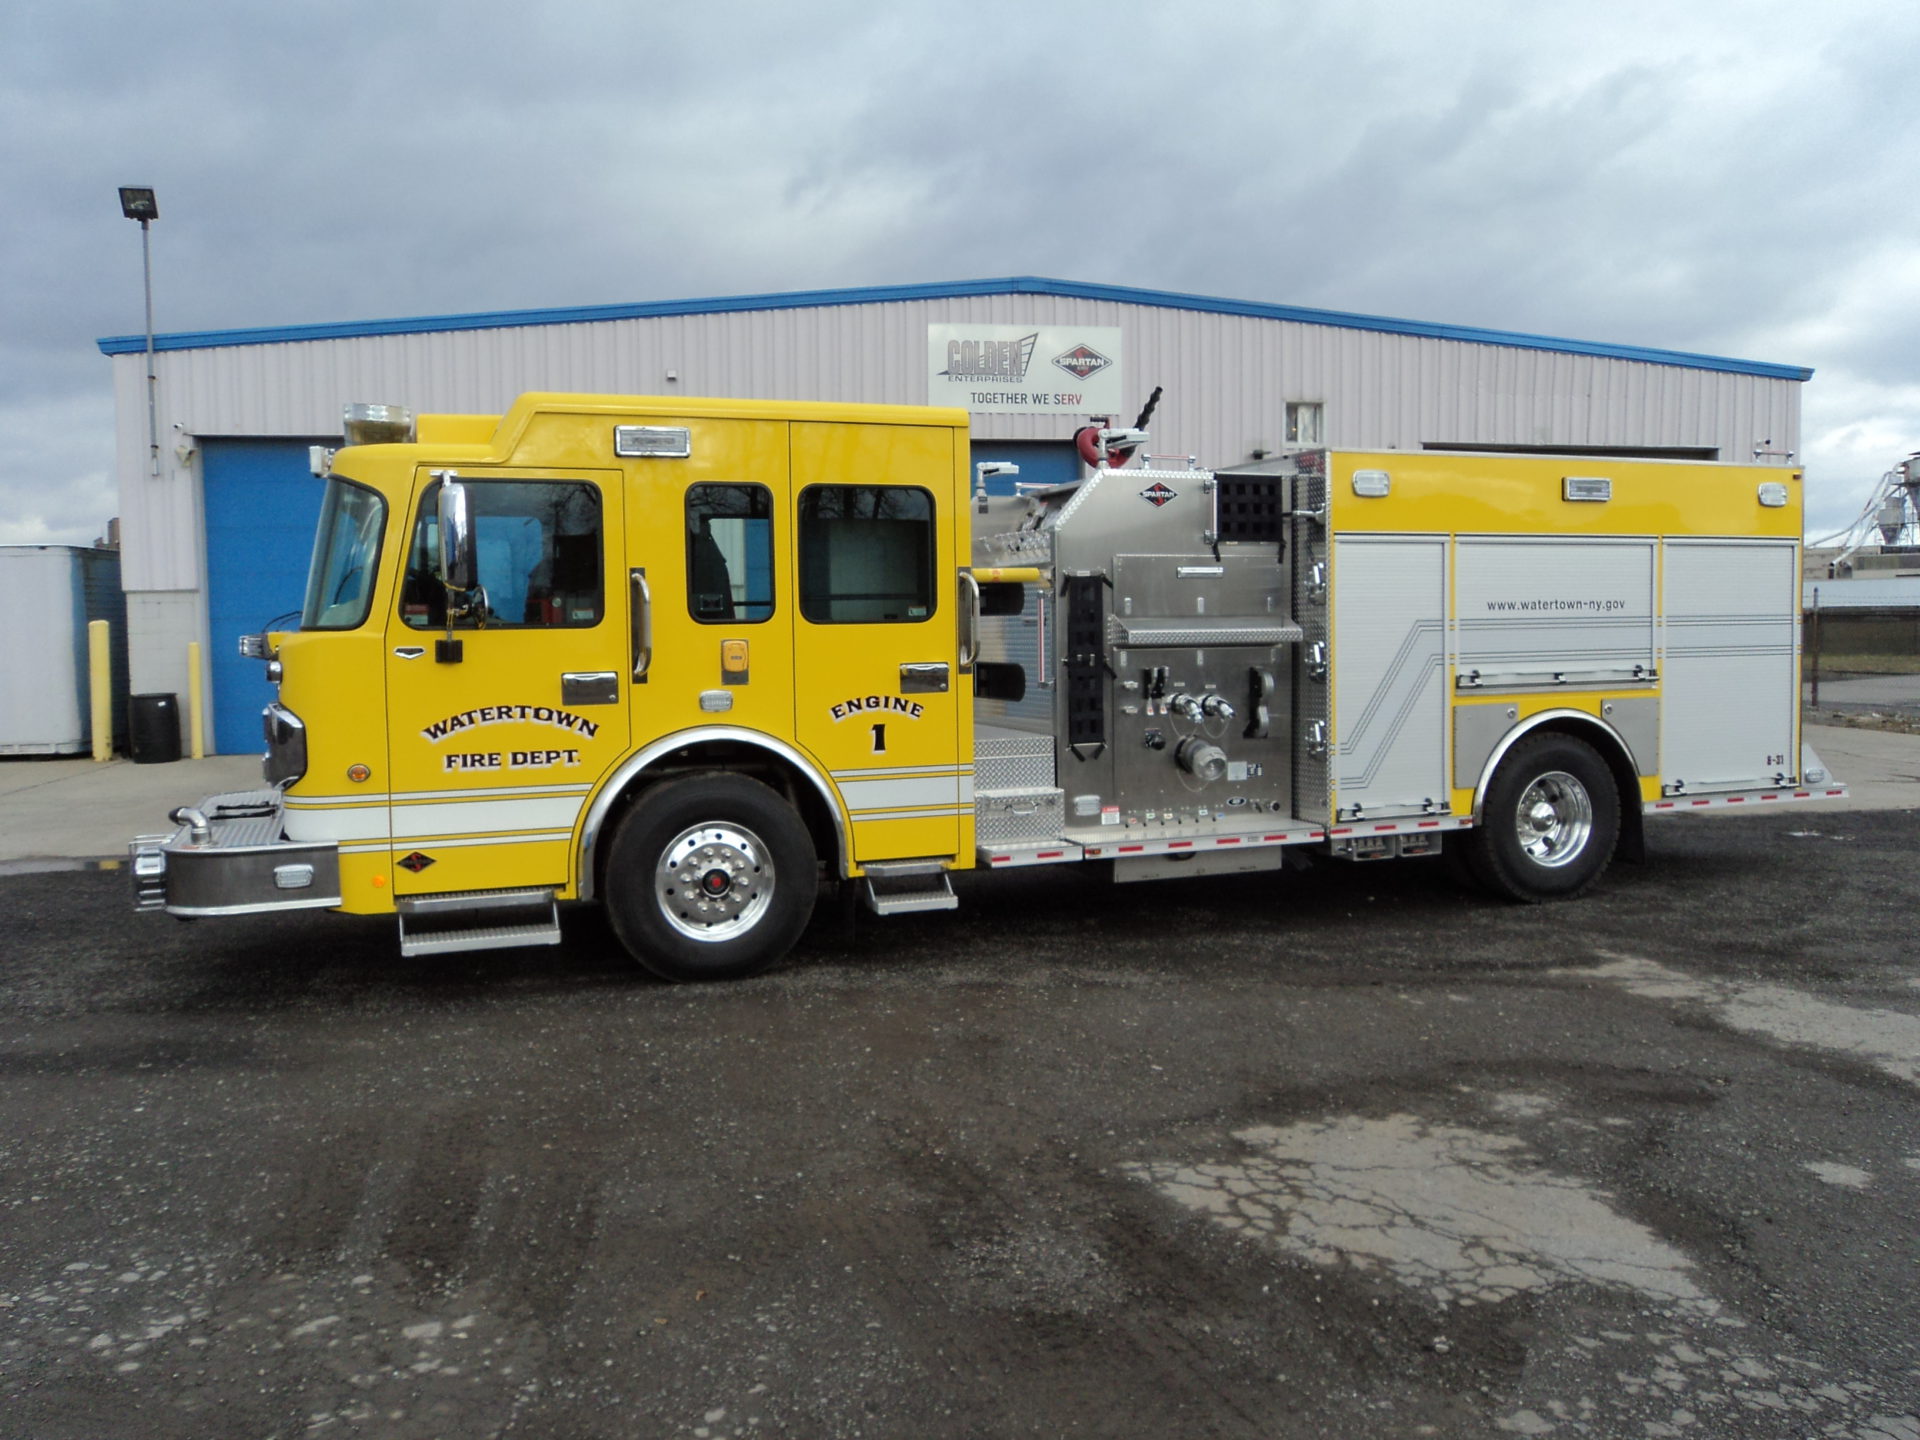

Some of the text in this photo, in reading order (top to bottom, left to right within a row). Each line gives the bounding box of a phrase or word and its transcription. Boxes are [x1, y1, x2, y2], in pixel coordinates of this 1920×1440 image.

[947, 340, 1023, 375] COLDEN
[1059, 357, 1105, 367] SPARTAN
[948, 375, 1023, 383] ENTERPRISES
[971, 392, 1082, 405] TOGETHER WE SERV
[1487, 599, 1625, 611] www.watertown-ny.gov
[829, 695, 924, 723] ENGINE
[421, 704, 599, 743] WATERTOWN
[869, 723, 887, 755] 1
[443, 749, 582, 772] FIRE DEPT.
